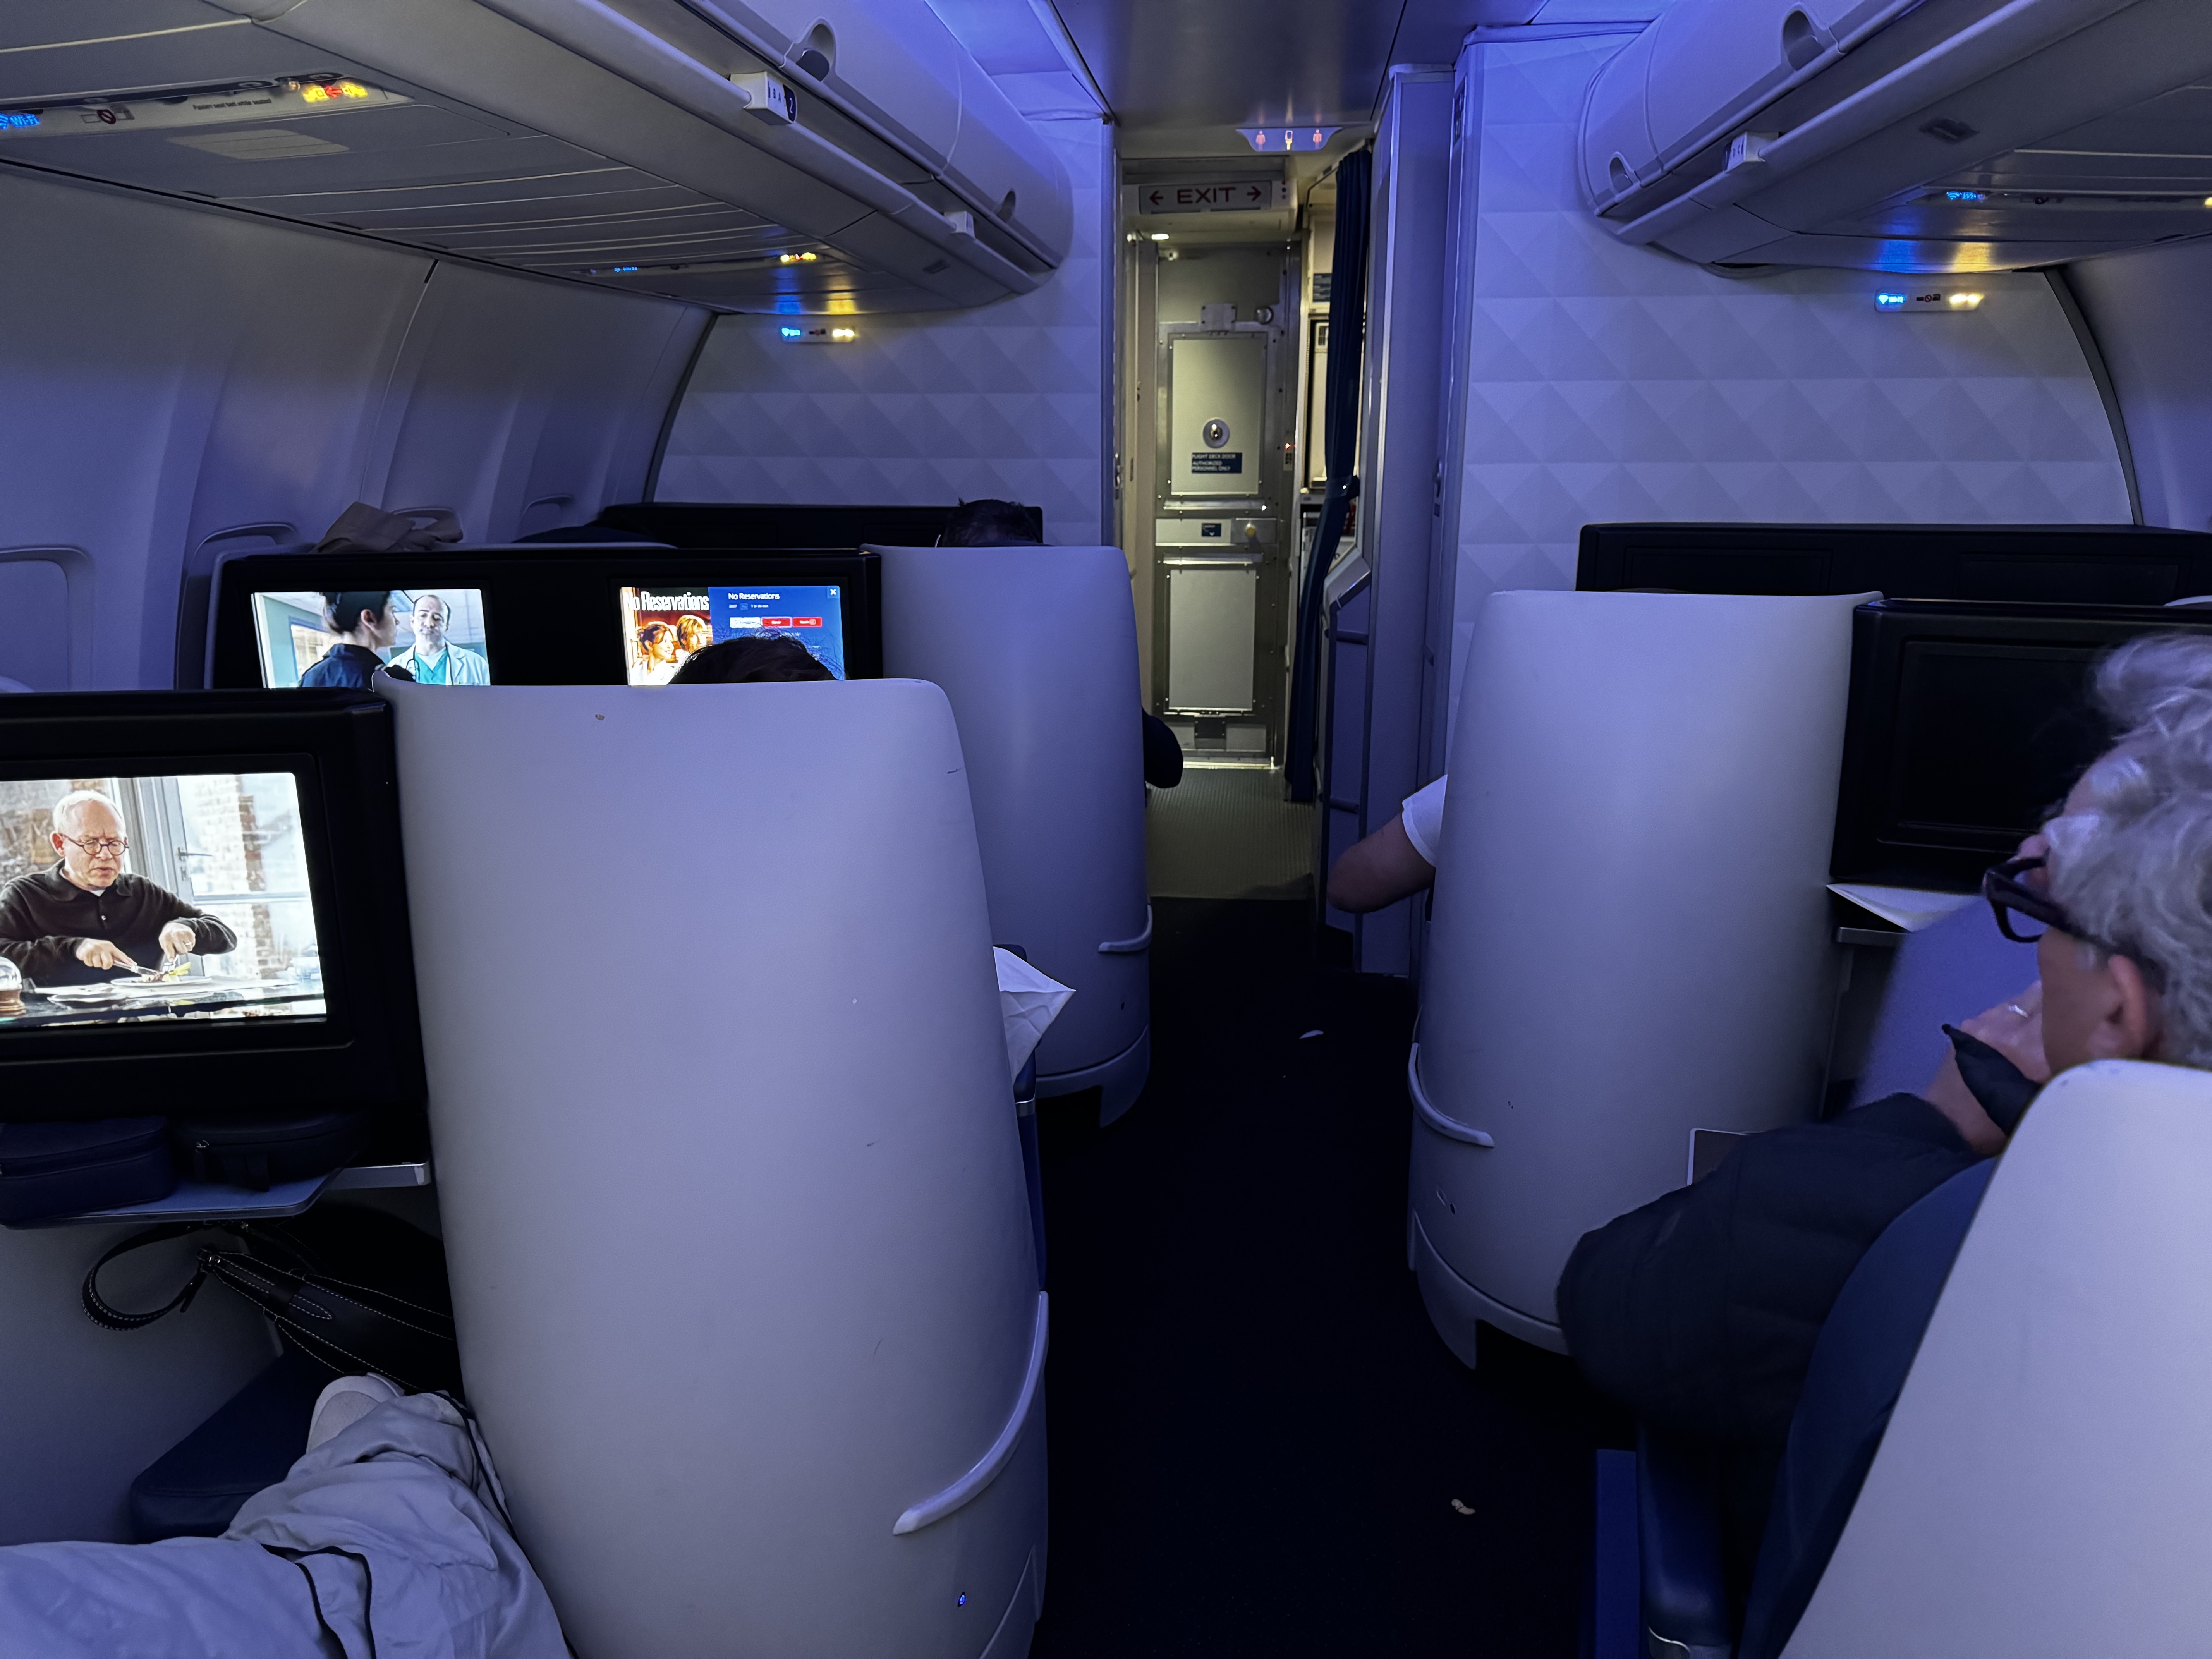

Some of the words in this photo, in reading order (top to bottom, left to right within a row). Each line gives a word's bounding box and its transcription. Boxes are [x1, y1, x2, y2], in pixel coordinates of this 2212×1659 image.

[789, 98, 793, 113] 2
[9, 115, 39, 125] Wi-Fi
[1177, 187, 1236, 204] EXIT
[624, 592, 640, 611] No
[641, 591, 709, 611] Reservations
